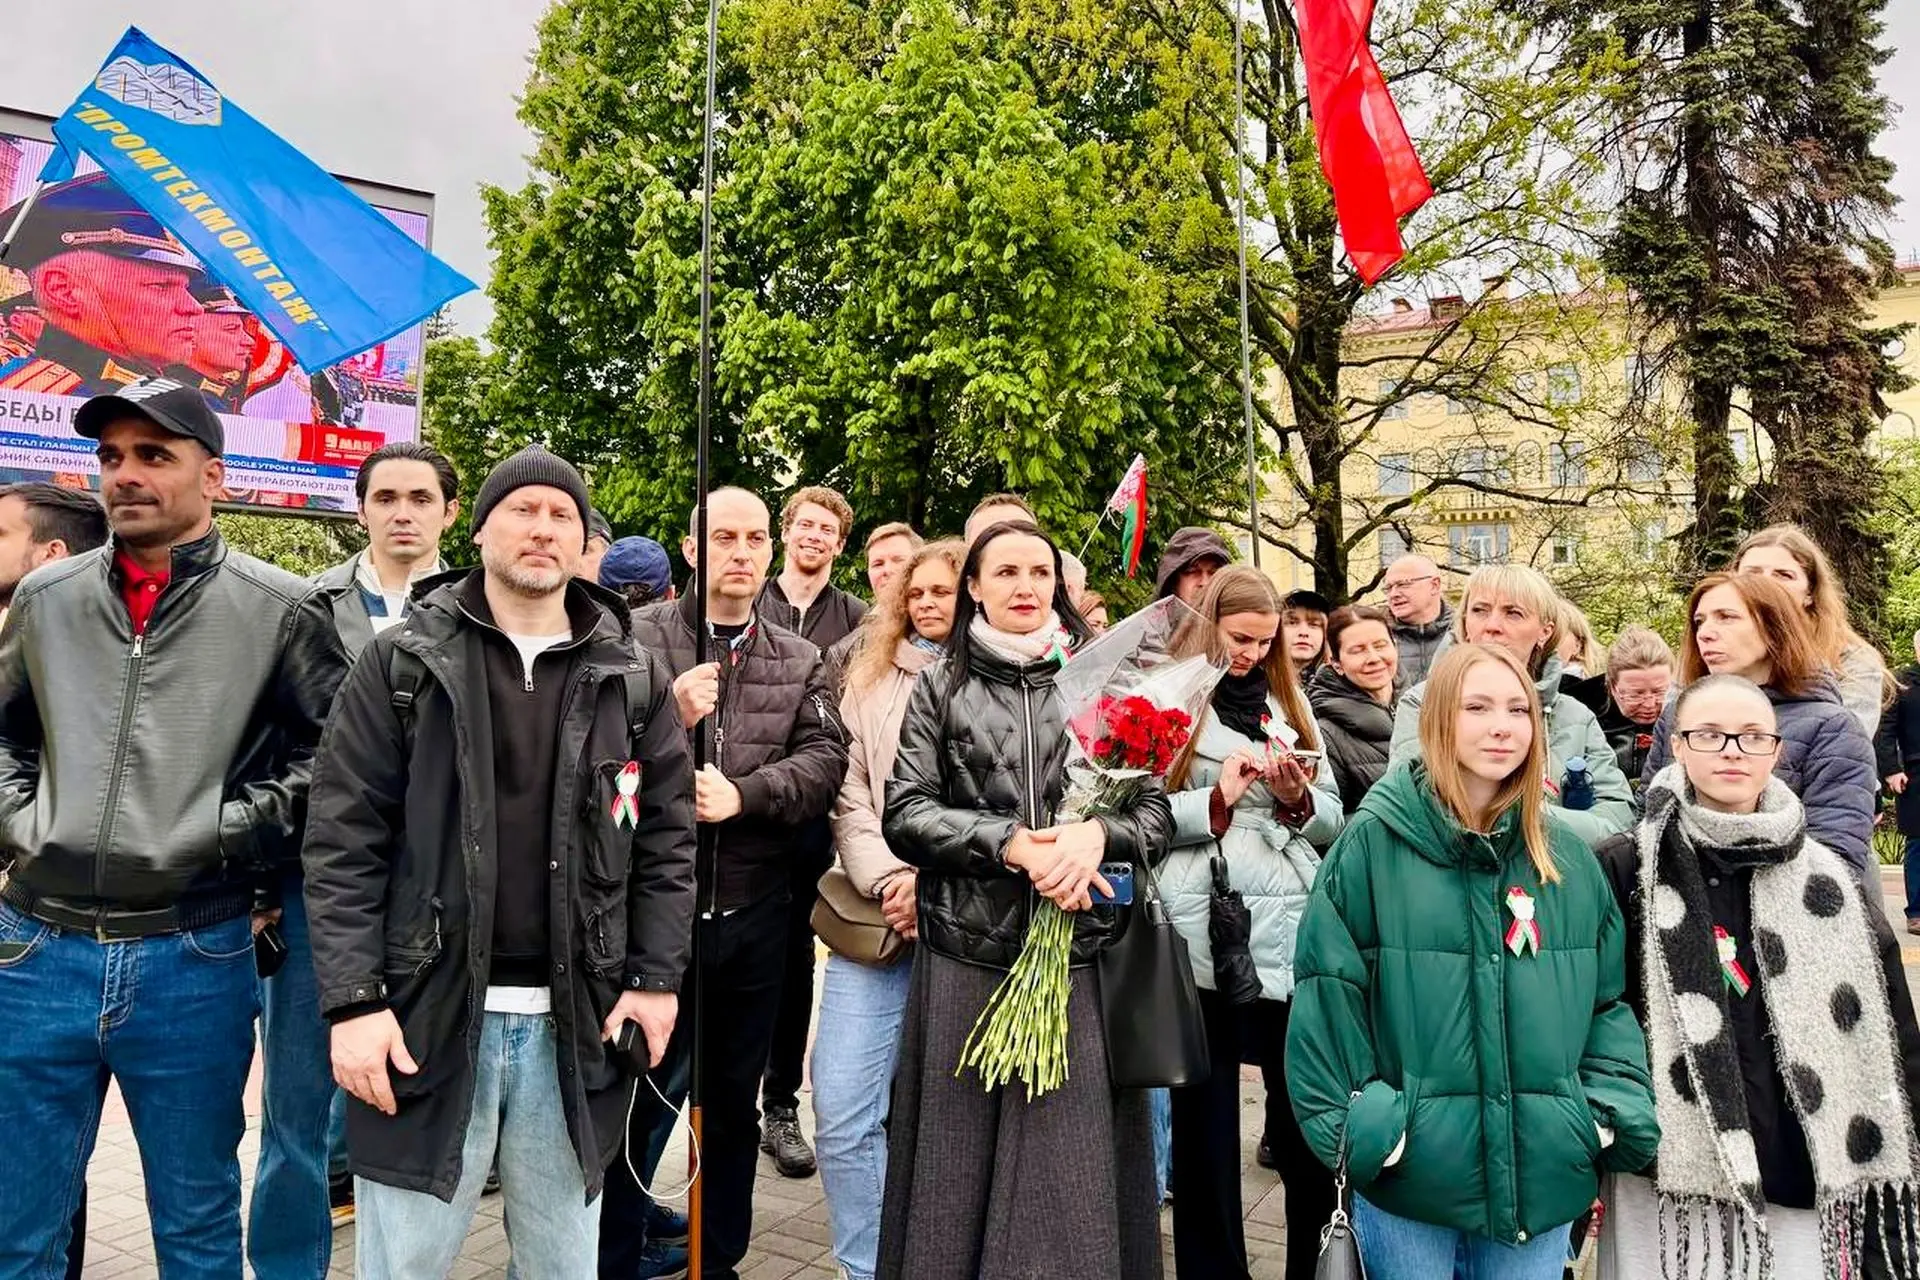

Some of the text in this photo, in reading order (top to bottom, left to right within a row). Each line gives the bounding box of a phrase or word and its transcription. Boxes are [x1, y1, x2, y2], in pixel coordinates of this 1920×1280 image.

[325, 433, 373, 452] 9 МАЯ
[10, 438, 37, 448] СТАЛ
[39, 441, 91, 453] ГЛАВНЫМ
[259, 461, 289, 472] УТРОМ
[34, 455, 98, 468] САВАННА
